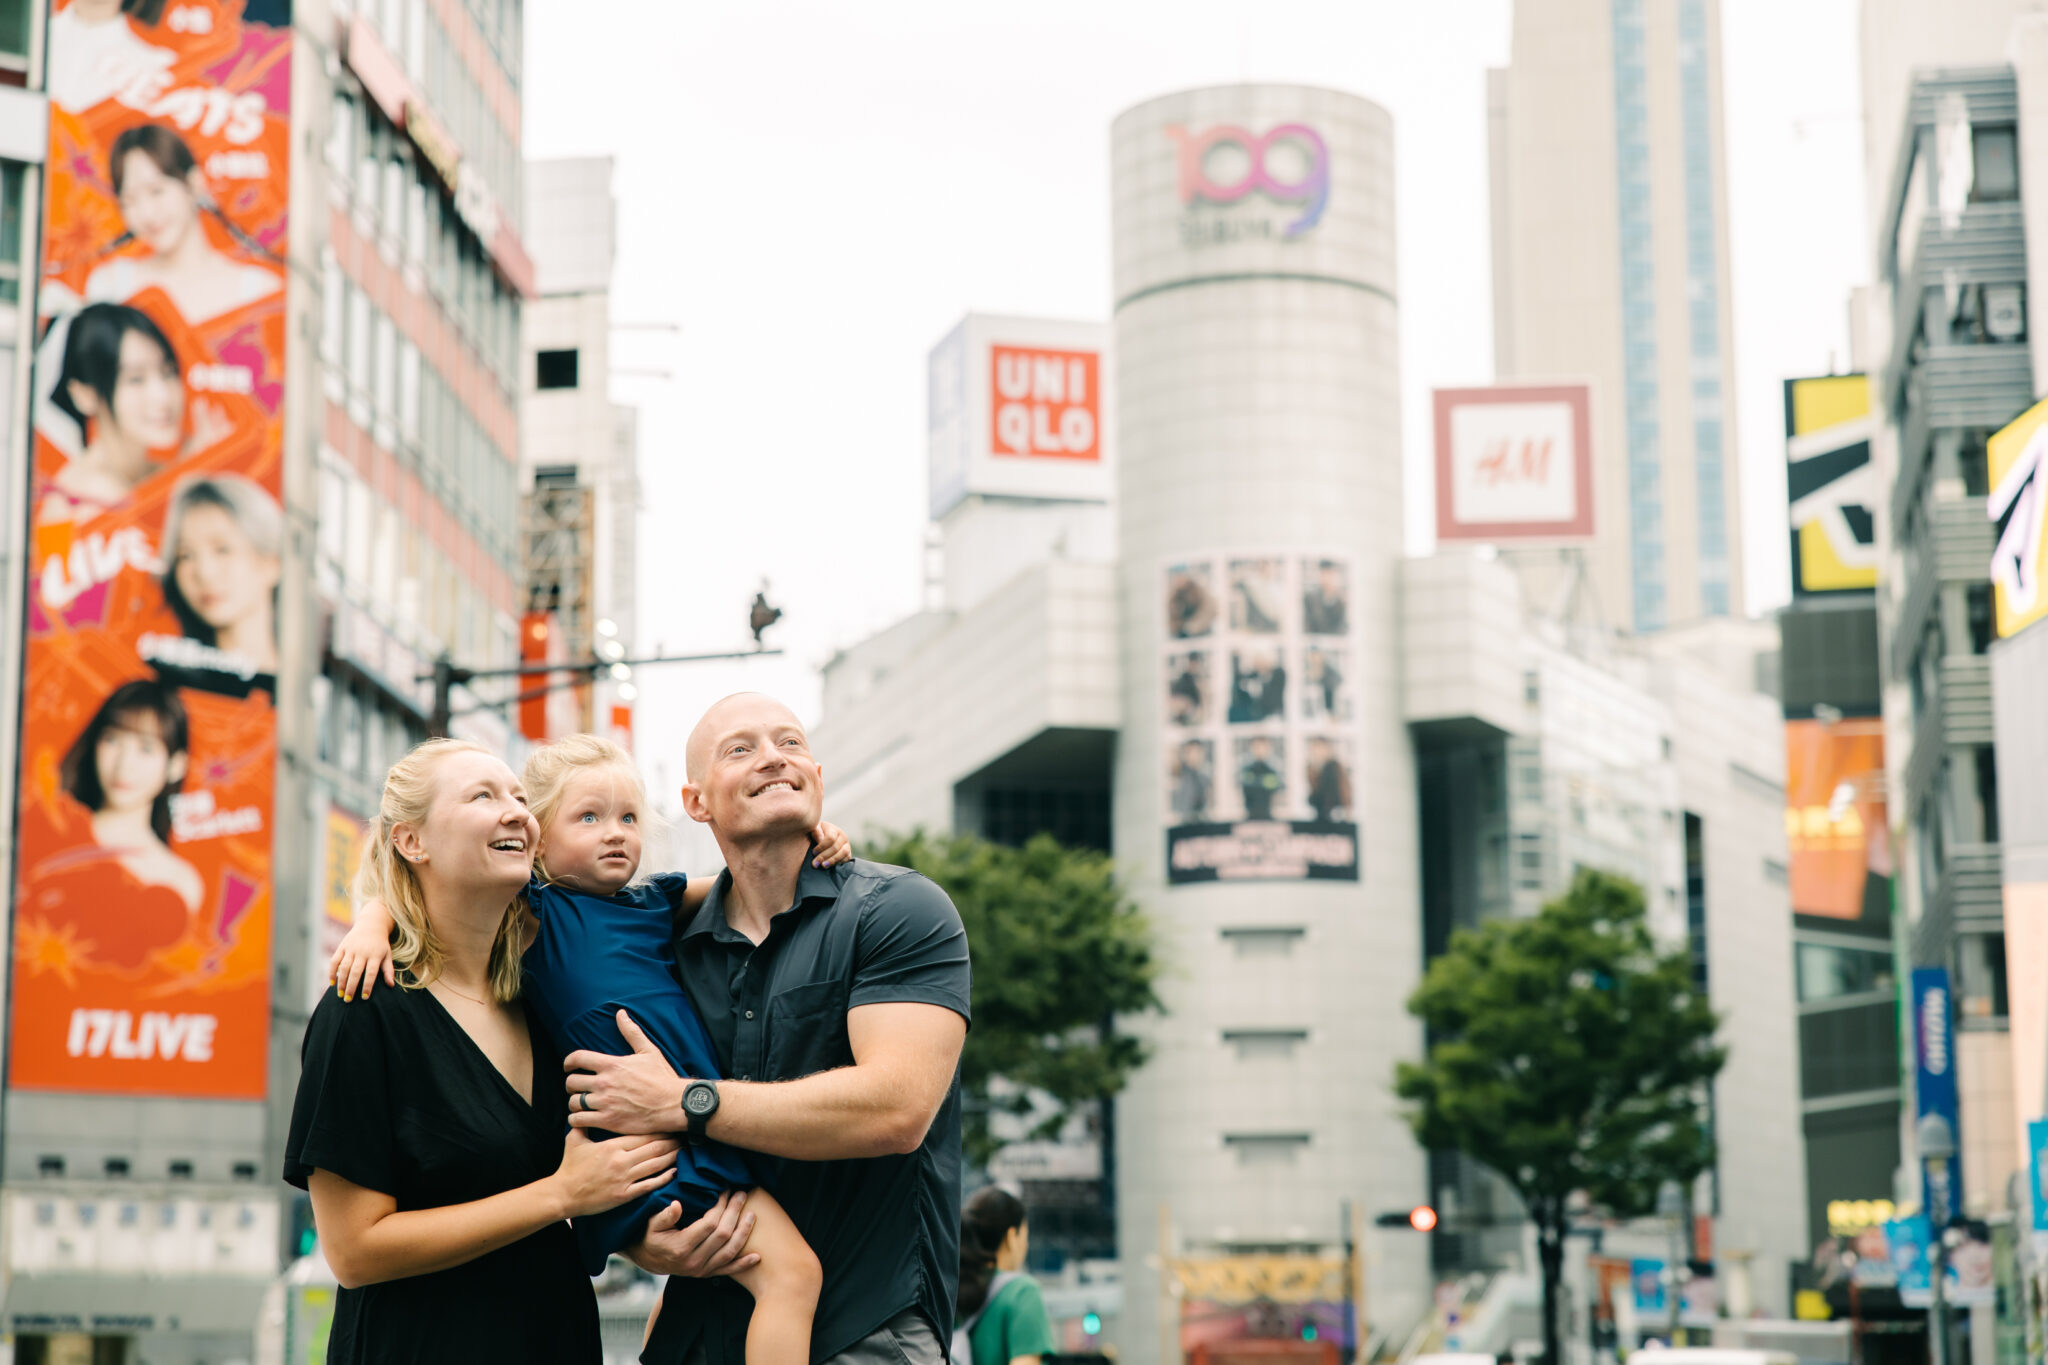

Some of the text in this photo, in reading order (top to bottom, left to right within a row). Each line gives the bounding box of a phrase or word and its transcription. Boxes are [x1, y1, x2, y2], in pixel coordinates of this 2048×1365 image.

[1162, 123, 1330, 238] 109
[998, 353, 1085, 404] UNI
[997, 402, 1095, 456] QLO
